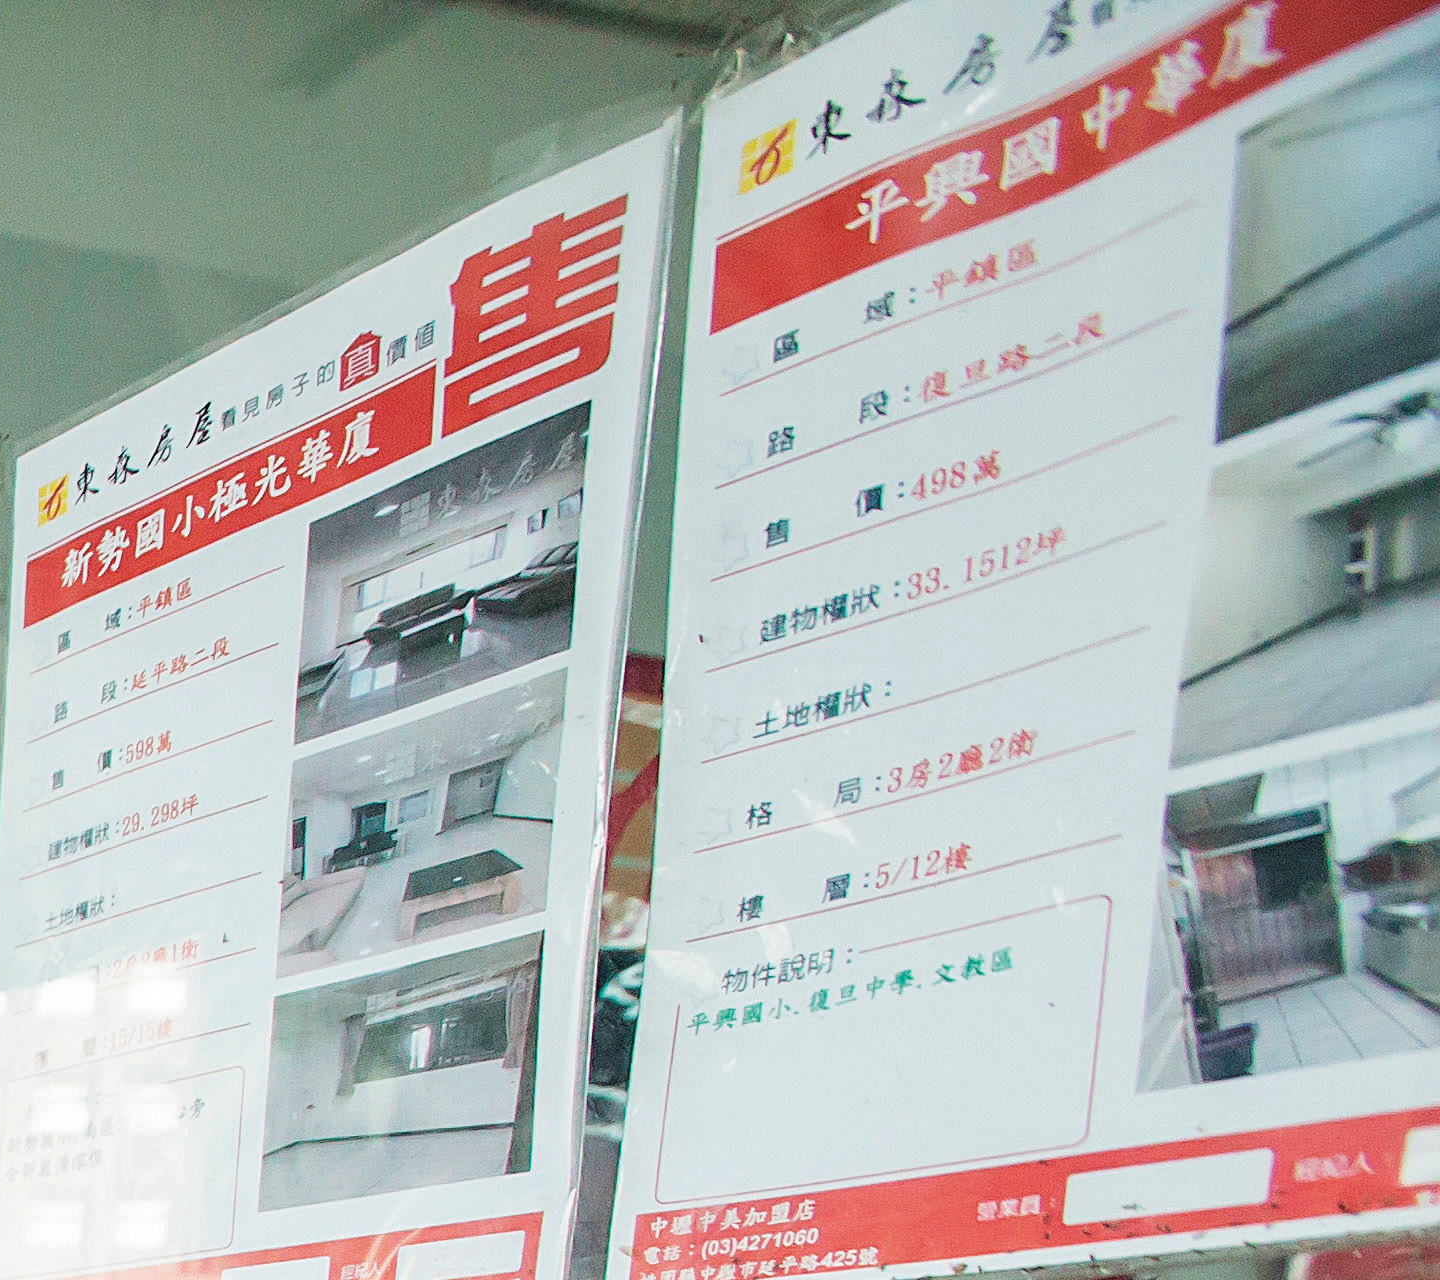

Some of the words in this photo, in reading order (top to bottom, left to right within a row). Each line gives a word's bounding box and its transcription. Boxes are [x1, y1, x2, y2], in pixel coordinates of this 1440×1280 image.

[845, 0, 1286, 243] 平興國中華廈
[441, 194, 628, 438] 售
[62, 408, 380, 588] 新勢國小極光華廈
[75, 401, 213, 504] 東森房屋
